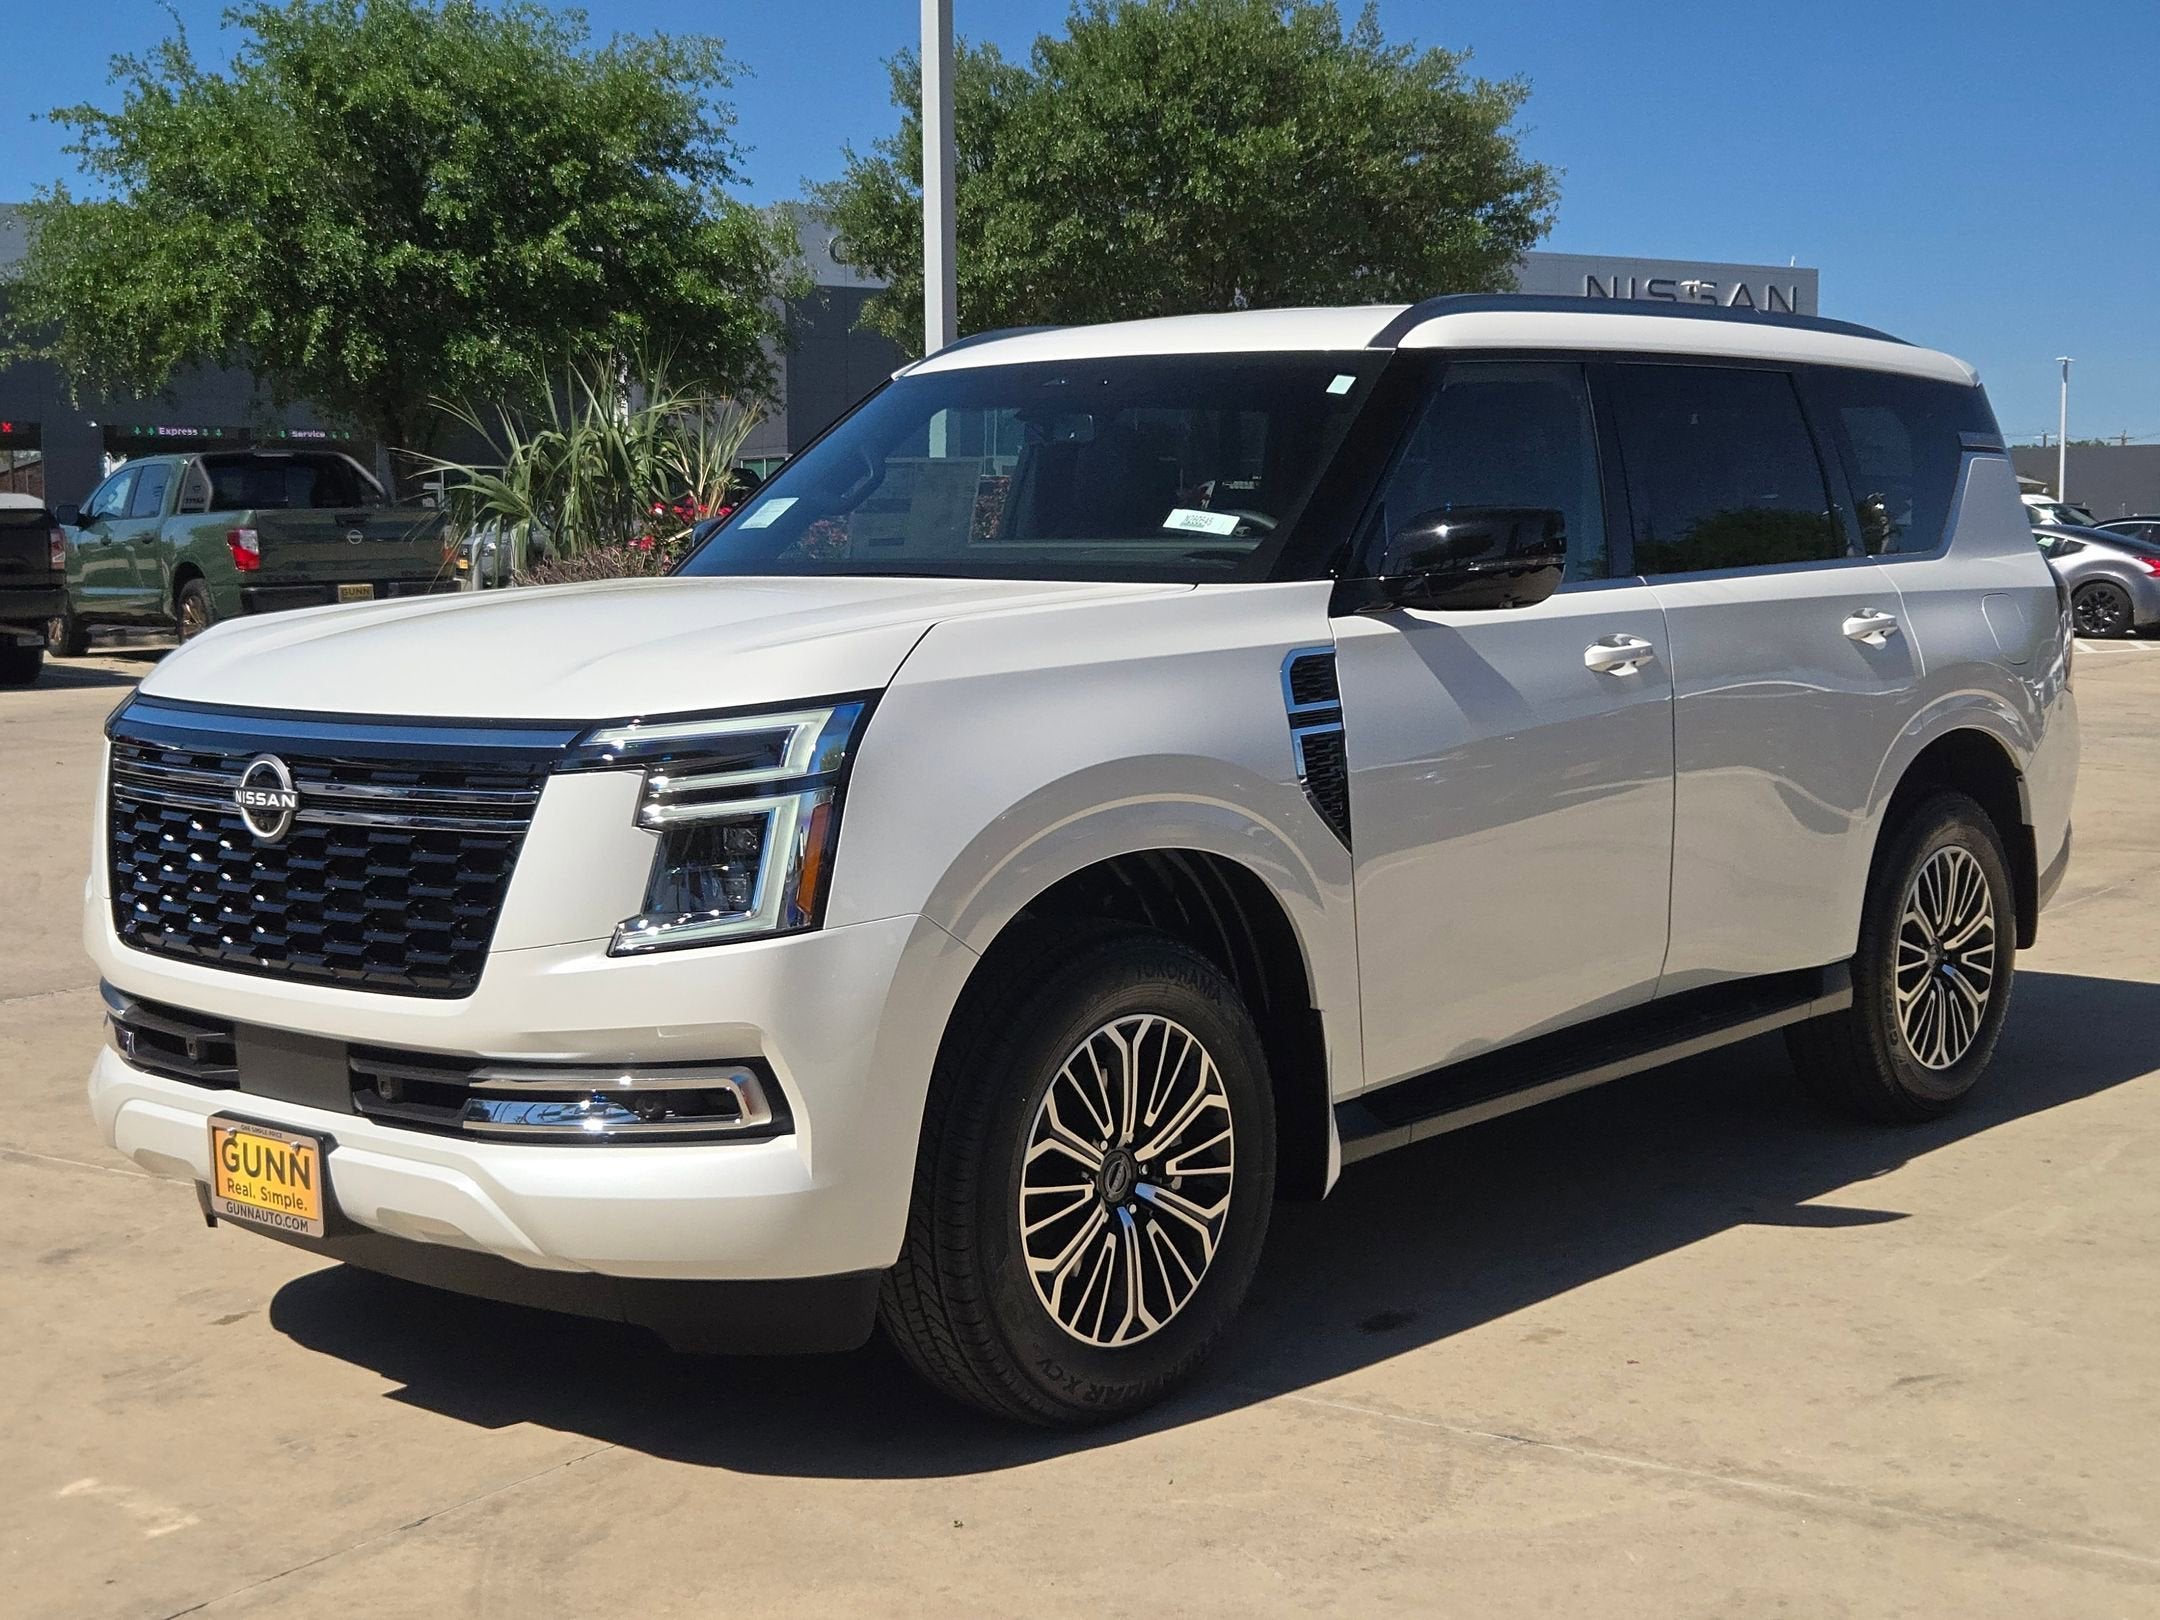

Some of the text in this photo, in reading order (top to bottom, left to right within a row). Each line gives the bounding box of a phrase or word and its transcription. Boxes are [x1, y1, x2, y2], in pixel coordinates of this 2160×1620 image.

[158, 427, 199, 437] Express
[291, 429, 327, 438] Service
[341, 587, 371, 597] GUNN
[235, 789, 296, 808] NISSAN
[221, 1137, 311, 1191] GUNN
[227, 1178, 308, 1211] Real. Simple.
[226, 1201, 309, 1233] GUNNAUTO.COM
